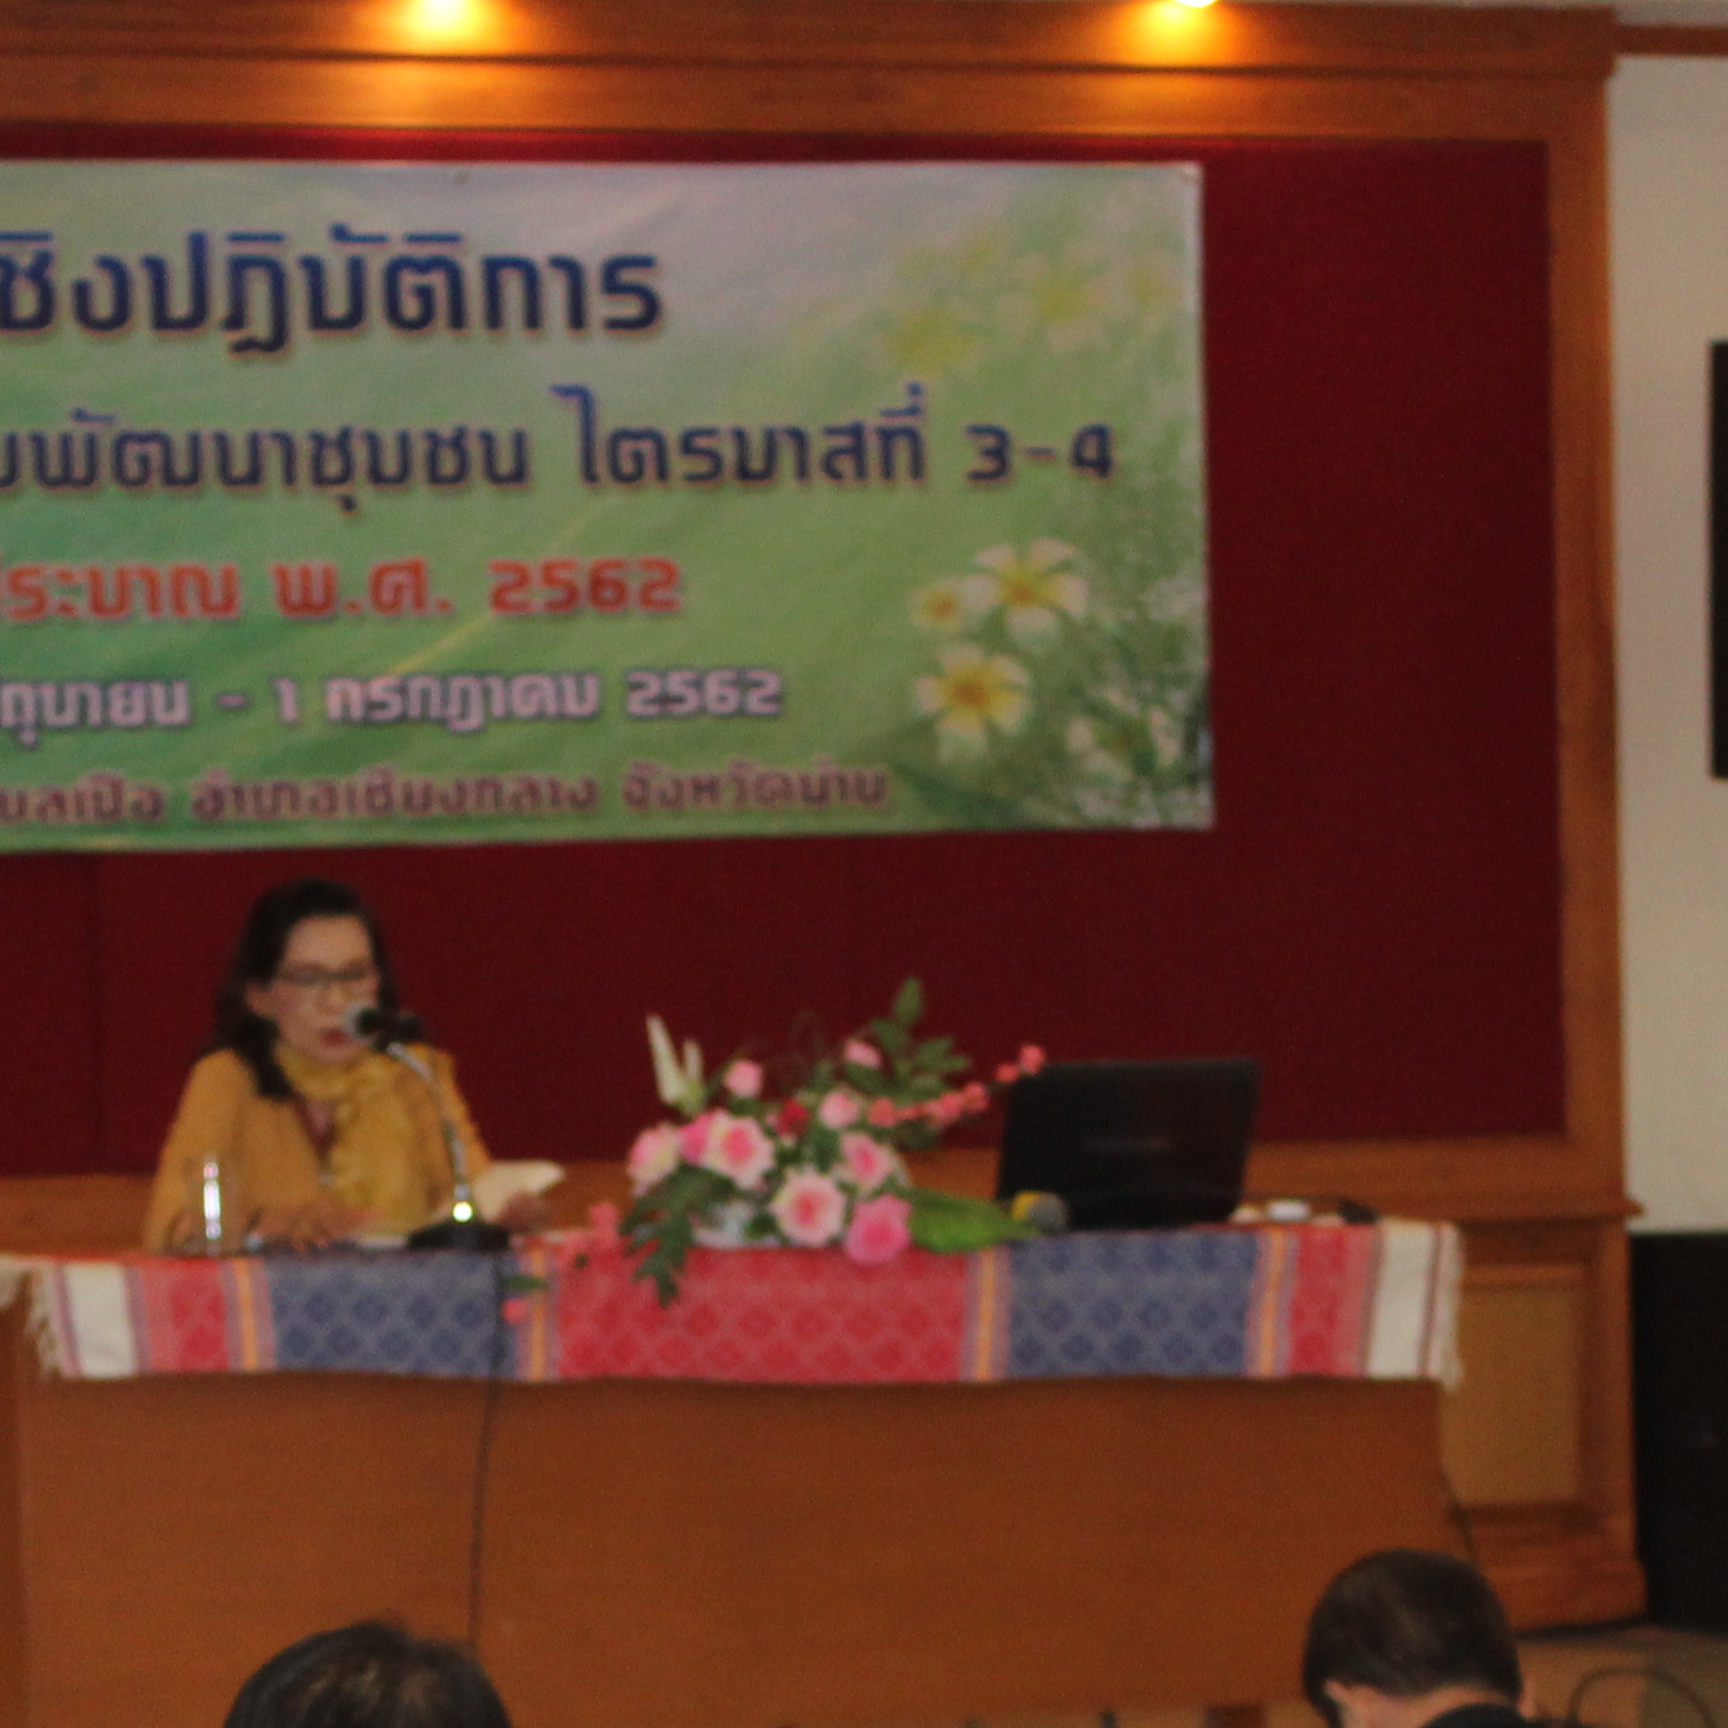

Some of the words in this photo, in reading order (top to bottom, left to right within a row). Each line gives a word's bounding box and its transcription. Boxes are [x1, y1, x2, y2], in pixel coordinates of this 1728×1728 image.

[551, 383, 927, 488] ไตรมาสที่
[272, 556, 455, 621] พ.ศ.
[487, 556, 684, 617] 2562
[326, 672, 600, 733] กรกฎาคม
[626, 668, 782, 718] 2562
[191, 764, 600, 821] อำเภอเชียงกลาง
[621, 755, 889, 811] จังหวัดน่าน
